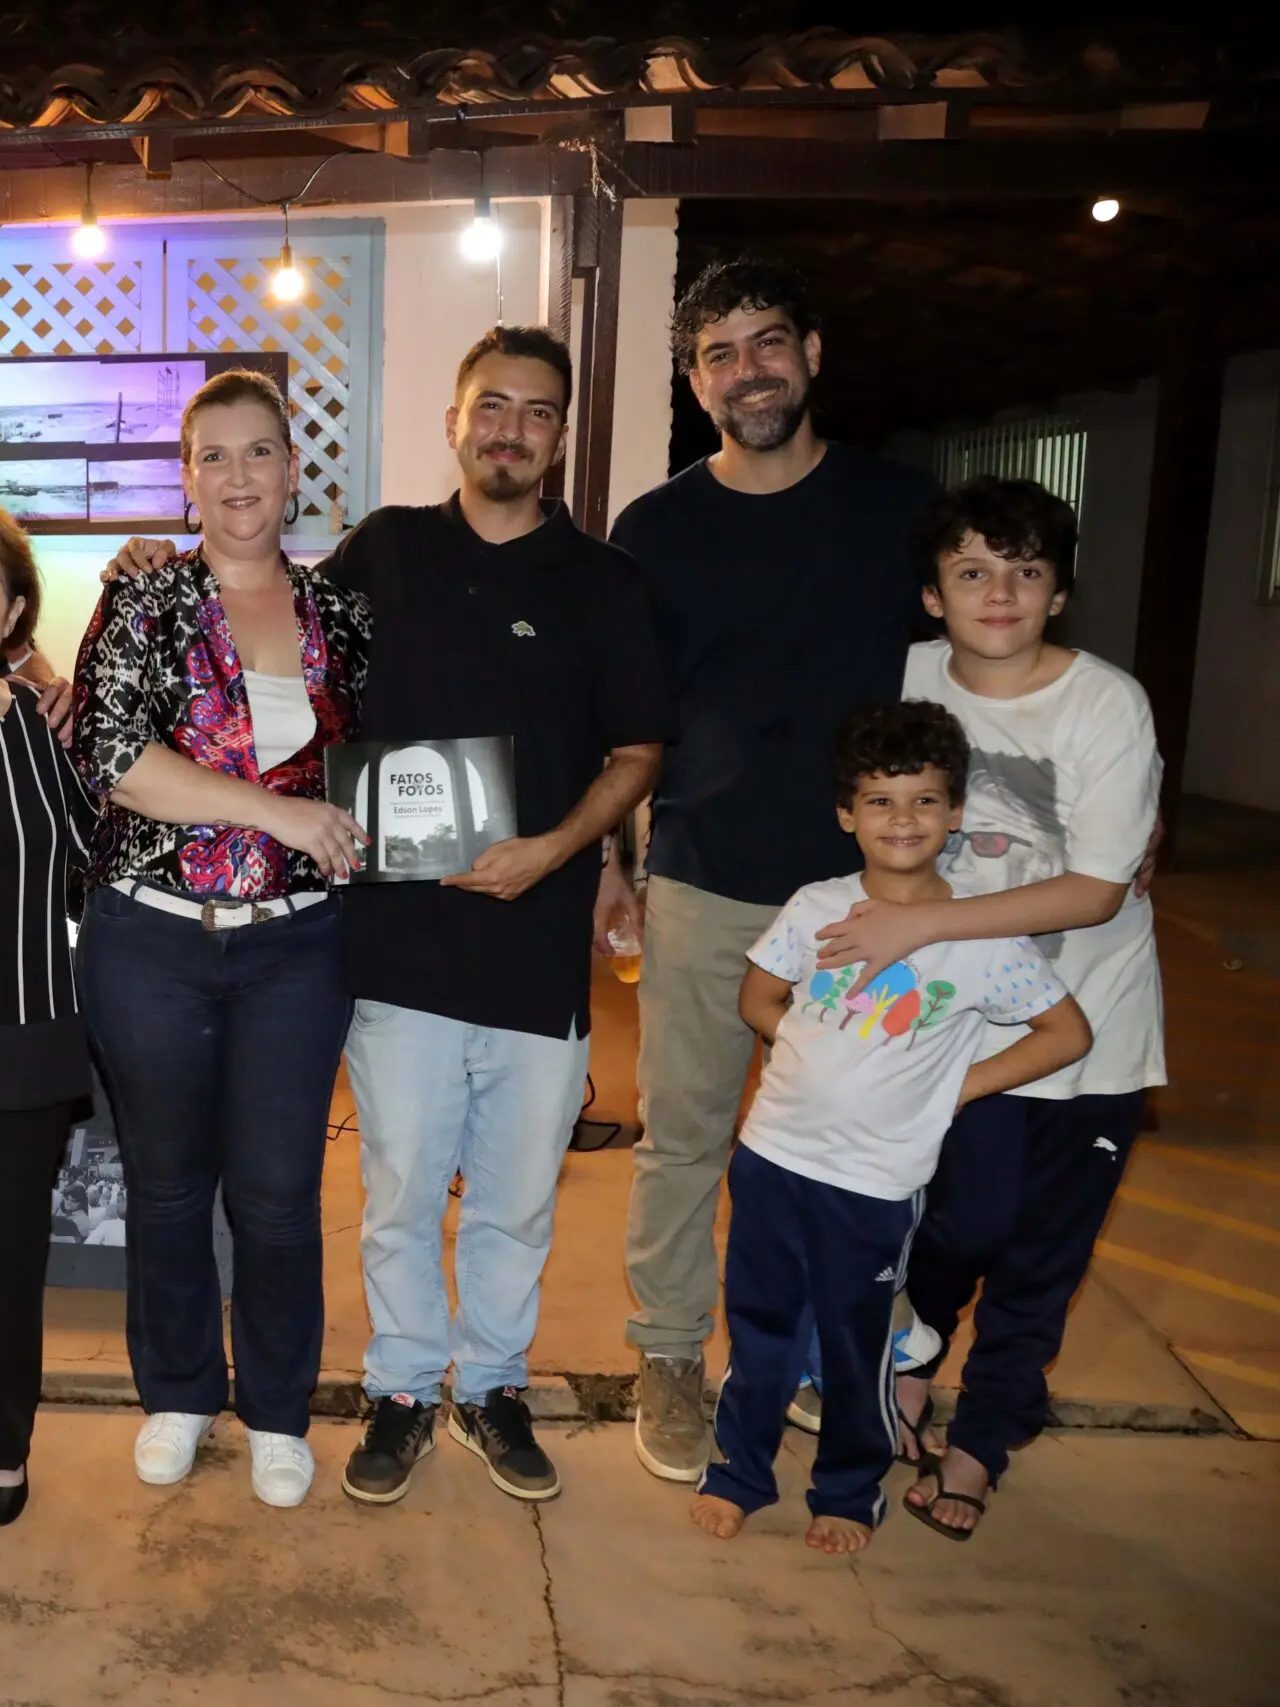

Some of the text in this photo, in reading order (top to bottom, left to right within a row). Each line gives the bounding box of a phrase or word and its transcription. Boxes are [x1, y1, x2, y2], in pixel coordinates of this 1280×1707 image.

[390, 773, 433, 785] FATOS
[398, 784, 444, 796] FOTOS
[393, 806, 443, 814] Edson Lopes
